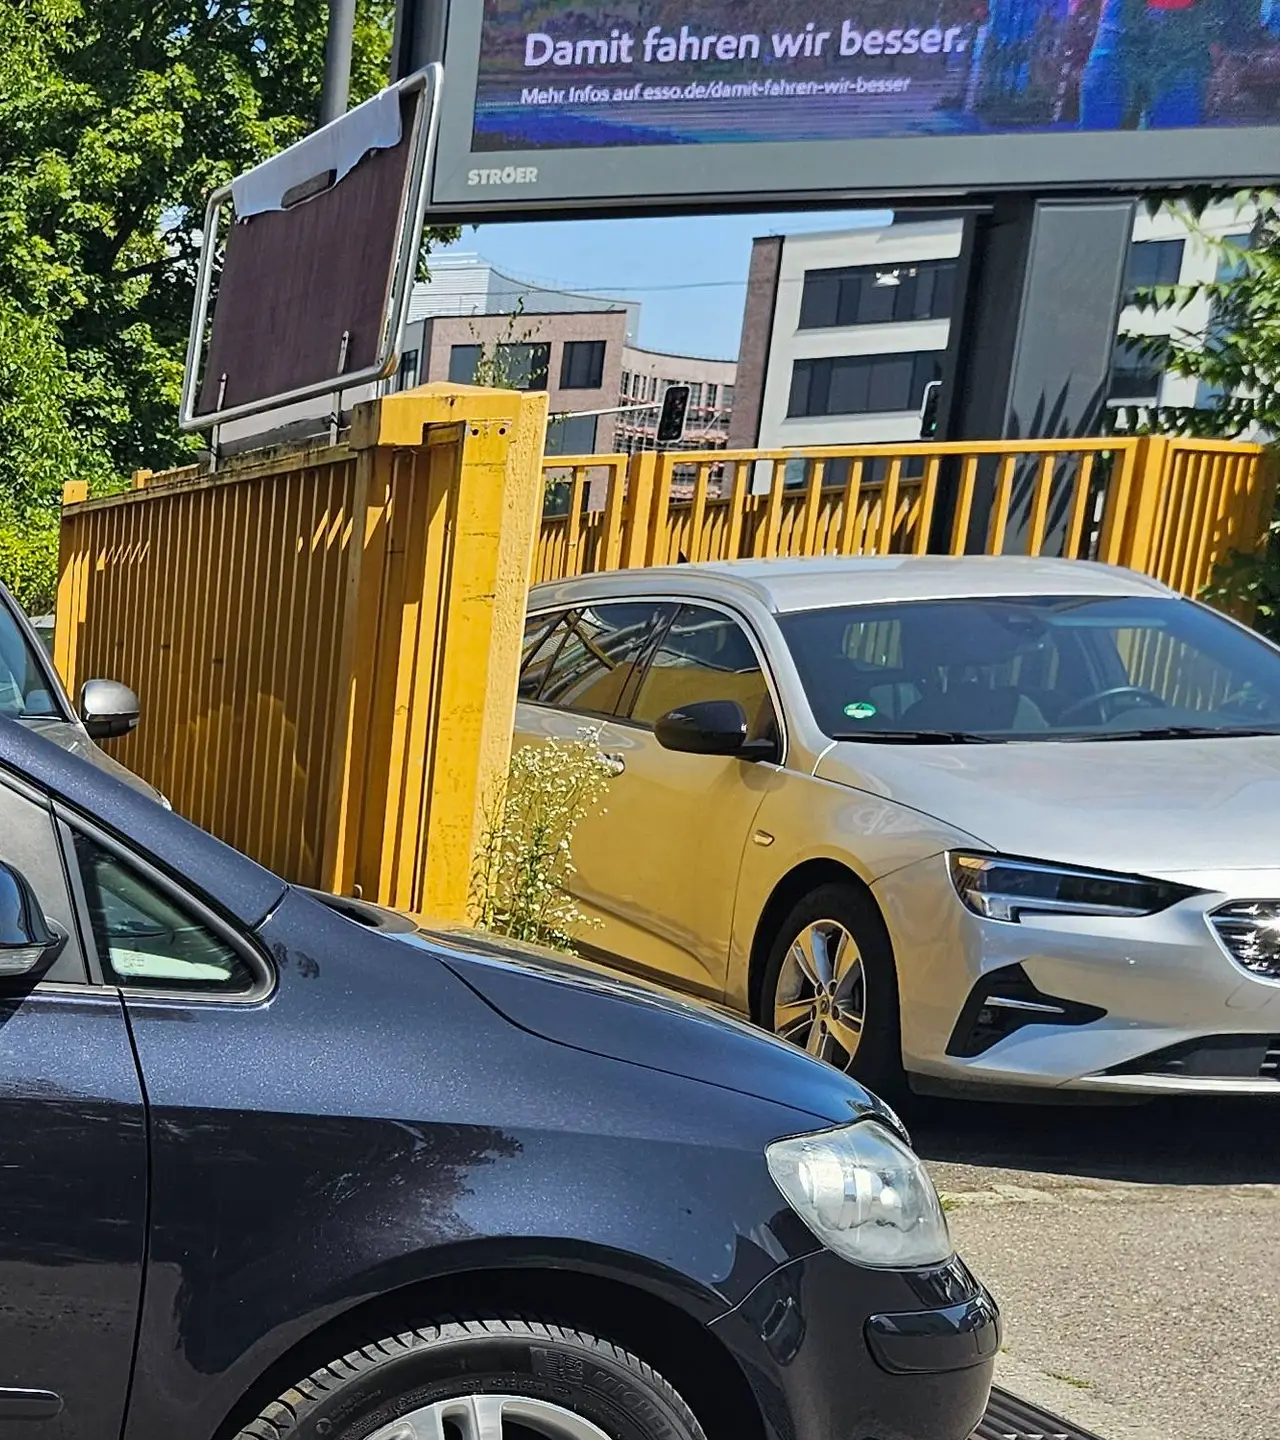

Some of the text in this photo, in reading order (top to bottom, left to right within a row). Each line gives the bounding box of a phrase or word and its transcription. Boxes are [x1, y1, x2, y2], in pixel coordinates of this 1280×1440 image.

[524, 18, 969, 67] Damit fahren wir besser.
[519, 75, 911, 105] Mehr Infos auf esso.de/damit-fahren-wir-besser
[467, 166, 538, 186] STRÖER
